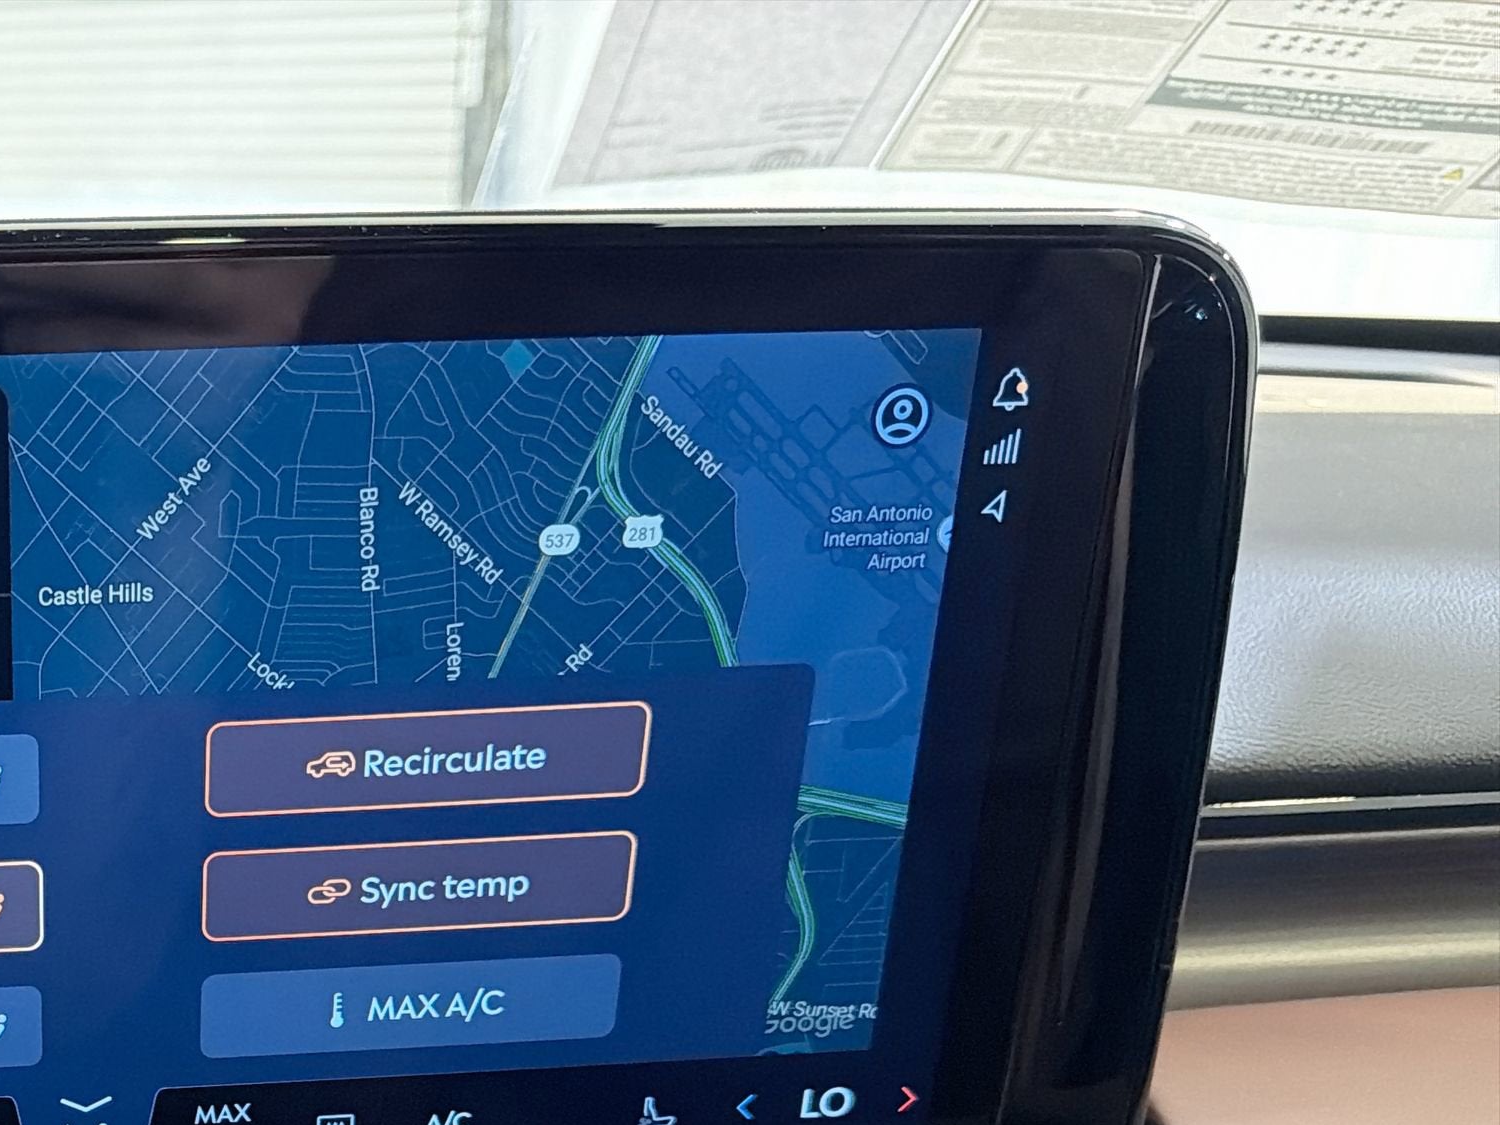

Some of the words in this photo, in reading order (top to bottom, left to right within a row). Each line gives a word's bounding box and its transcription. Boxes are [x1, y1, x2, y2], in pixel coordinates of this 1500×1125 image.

[641, 395, 699, 458] Sandau
[694, 449, 723, 479] Rd
[136, 492, 183, 539] West
[179, 458, 211, 496] Ave
[359, 487, 379, 560] Blanco
[830, 506, 862, 524] San
[865, 503, 933, 522] Antonio
[399, 481, 422, 506] W
[415, 499, 479, 566] Ramsey
[474, 556, 503, 585] Rd
[545, 533, 575, 548] 537
[628, 527, 656, 543] 281
[823, 527, 930, 547] International
[867, 553, 926, 573] Airport
[361, 565, 380, 592] Rd
[38, 586, 102, 606] Castle
[108, 582, 154, 604] Hills
[565, 643, 593, 672] Rd
[363, 743, 547, 778] Recirculate
[360, 876, 436, 907] Sync
[442, 875, 530, 903] temp
[367, 993, 440, 1022] MAX
[444, 987, 505, 1023] A/C
[793, 1001, 855, 1019] Sunset
[194, 1102, 252, 1125] MAX
[799, 1086, 855, 1119] LO
